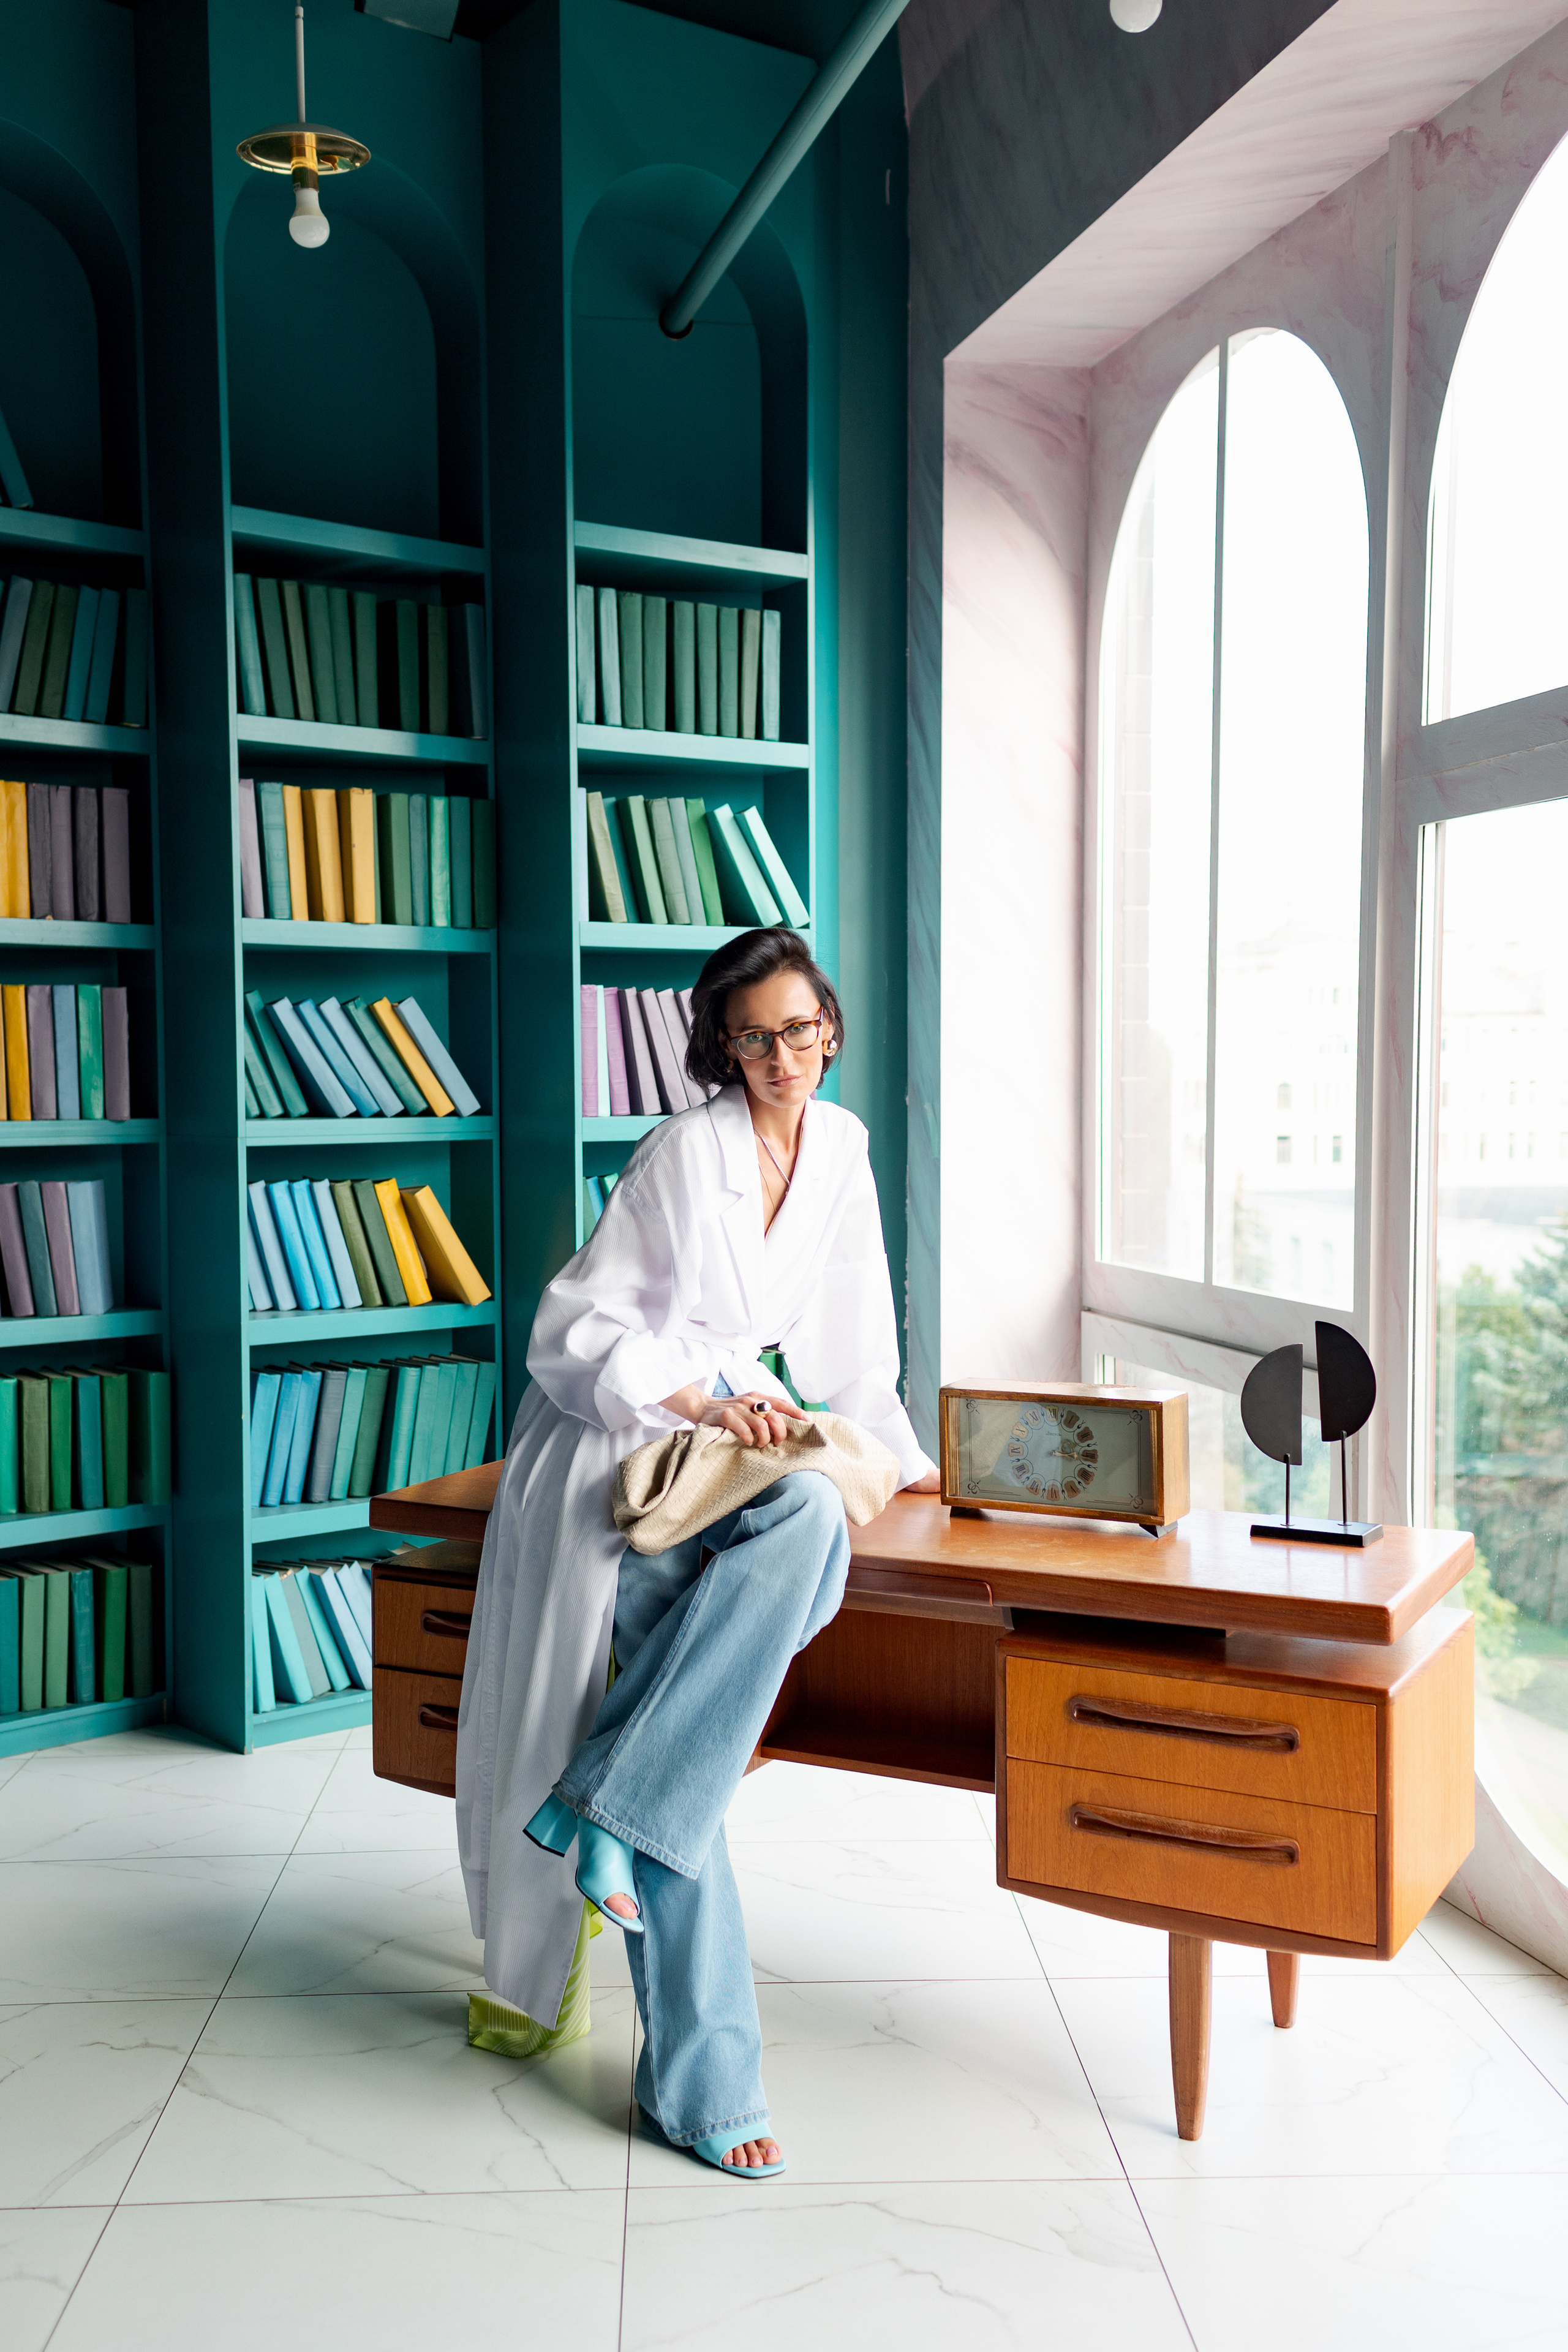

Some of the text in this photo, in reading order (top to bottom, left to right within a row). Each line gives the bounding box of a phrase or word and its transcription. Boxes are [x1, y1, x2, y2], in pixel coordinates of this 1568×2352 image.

[1029, 1411, 1039, 1422] XI
[1047, 1408, 1057, 1419] XII
[1068, 1415, 1074, 1424] I
[1016, 1425, 1026, 1436] X
[1011, 1446, 1020, 1454] IX
[1016, 1464, 1027, 1477] VIII
[1080, 1470, 1091, 1482] IIII
[1030, 1480, 1039, 1493] VII
[1069, 1485, 1077, 1495] V
[1050, 1487, 1057, 1499] VI
